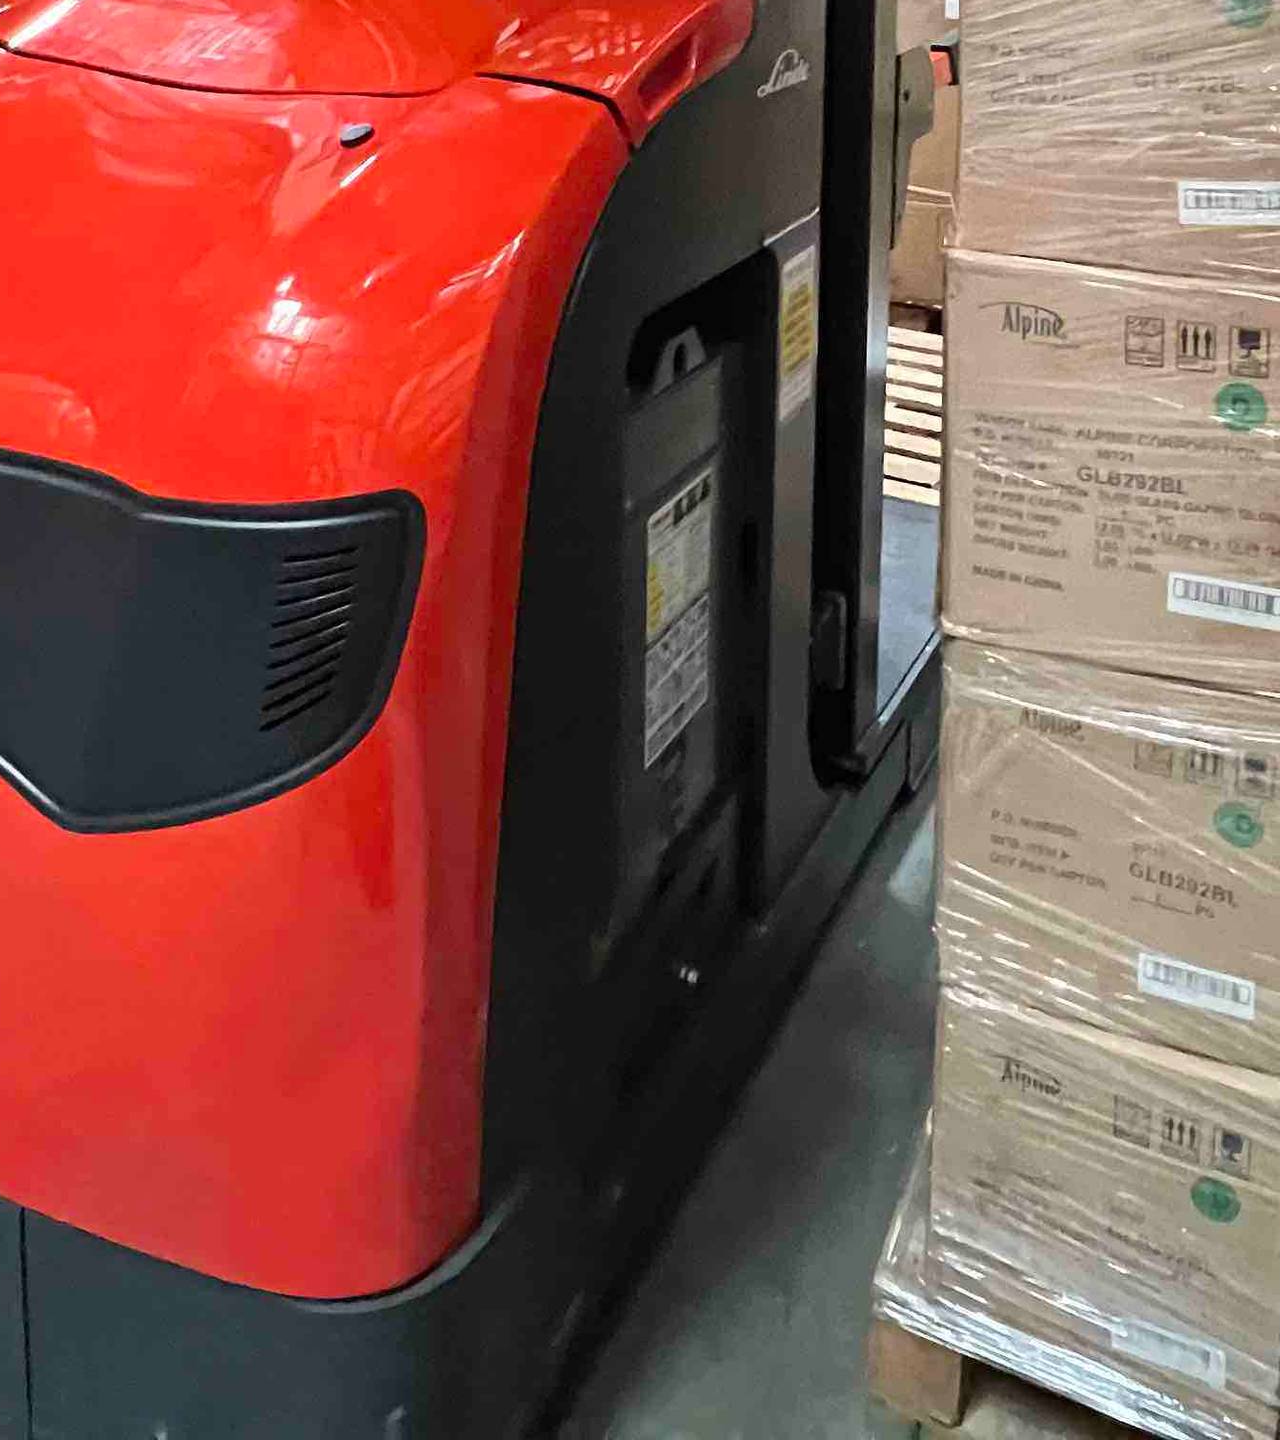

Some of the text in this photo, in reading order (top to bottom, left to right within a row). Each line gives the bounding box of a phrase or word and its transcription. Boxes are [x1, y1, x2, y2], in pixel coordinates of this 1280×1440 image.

[757, 49, 810, 97] Linde
[988, 301, 1069, 342] Alpine
[1129, 860, 1240, 908] GLB292BL
